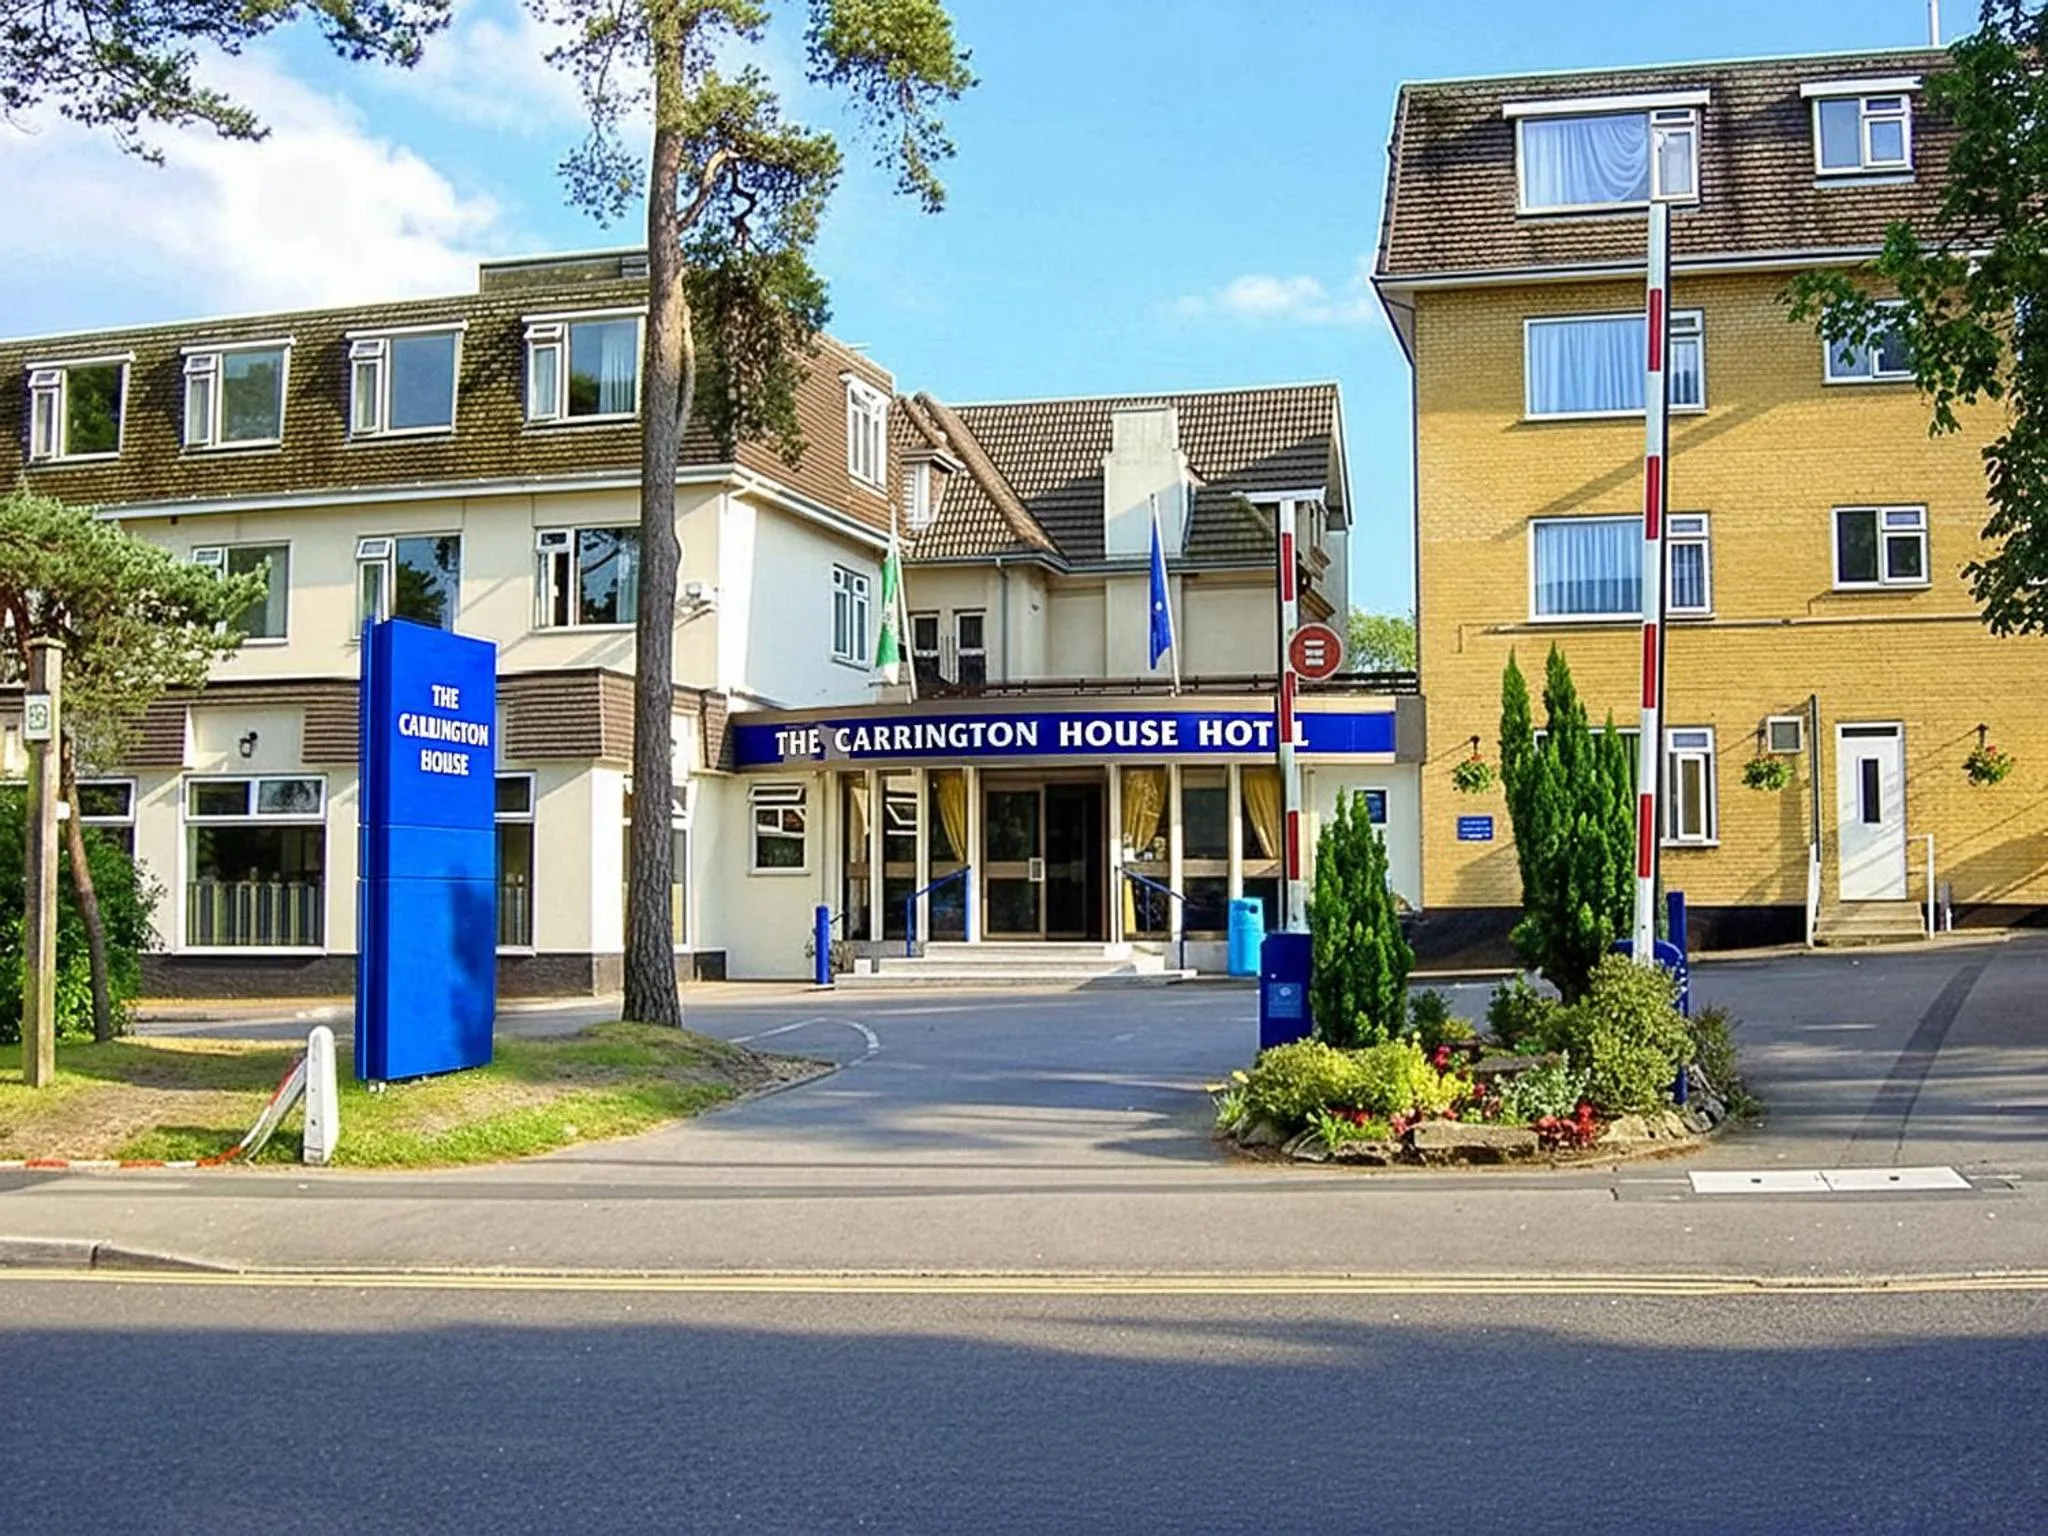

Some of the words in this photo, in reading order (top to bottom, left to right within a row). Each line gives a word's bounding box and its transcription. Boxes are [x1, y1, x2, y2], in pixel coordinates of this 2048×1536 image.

[432, 684, 459, 709] THE
[775, 729, 821, 756] THE
[833, 720, 1039, 752] CARRINGTON
[1059, 720, 1178, 747] HOUSE
[1199, 720, 1309, 747] HOTL
[421, 749, 469, 776] HOUSE
